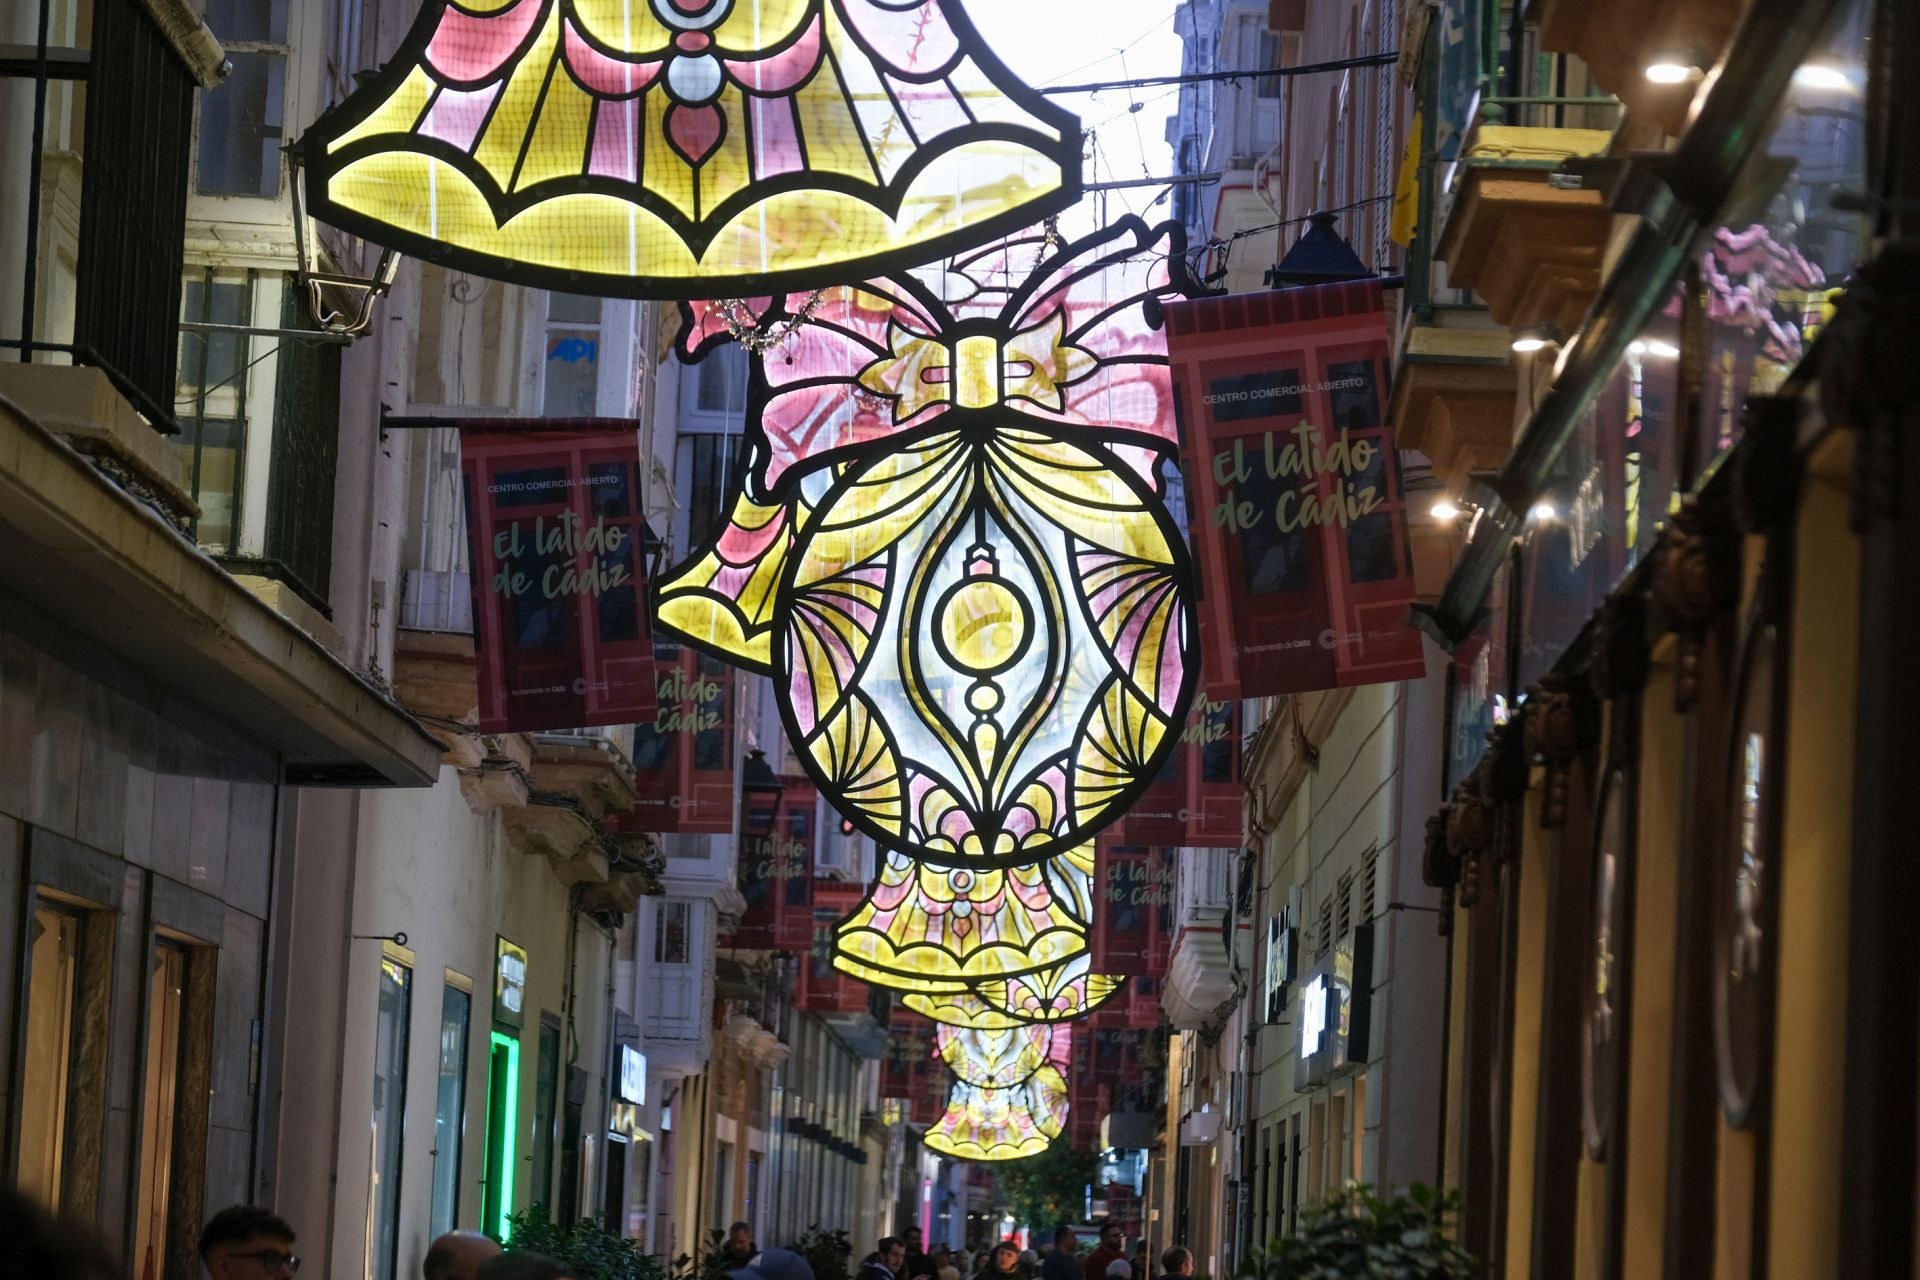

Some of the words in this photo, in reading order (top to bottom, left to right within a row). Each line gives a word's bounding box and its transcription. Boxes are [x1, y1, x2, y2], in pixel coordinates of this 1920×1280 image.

[1203, 391, 1248, 405] CENTRO
[1249, 384, 1314, 399] COMERCIAL
[1316, 377, 1364, 392] ABIERTO
[1213, 438, 1252, 486] El
[1264, 420, 1378, 479] latido
[487, 483, 525, 494] CENTRO
[526, 479, 577, 490] COMERCIAL
[579, 475, 619, 486] ABIERTO
[1211, 489, 1264, 535] de
[1275, 477, 1384, 533] Cádiz
[494, 521, 525, 560] El
[536, 507, 627, 556] latido
[489, 562, 533, 599] de
[542, 555, 630, 599] Cádiz
[654, 703, 723, 736] Cádiz
